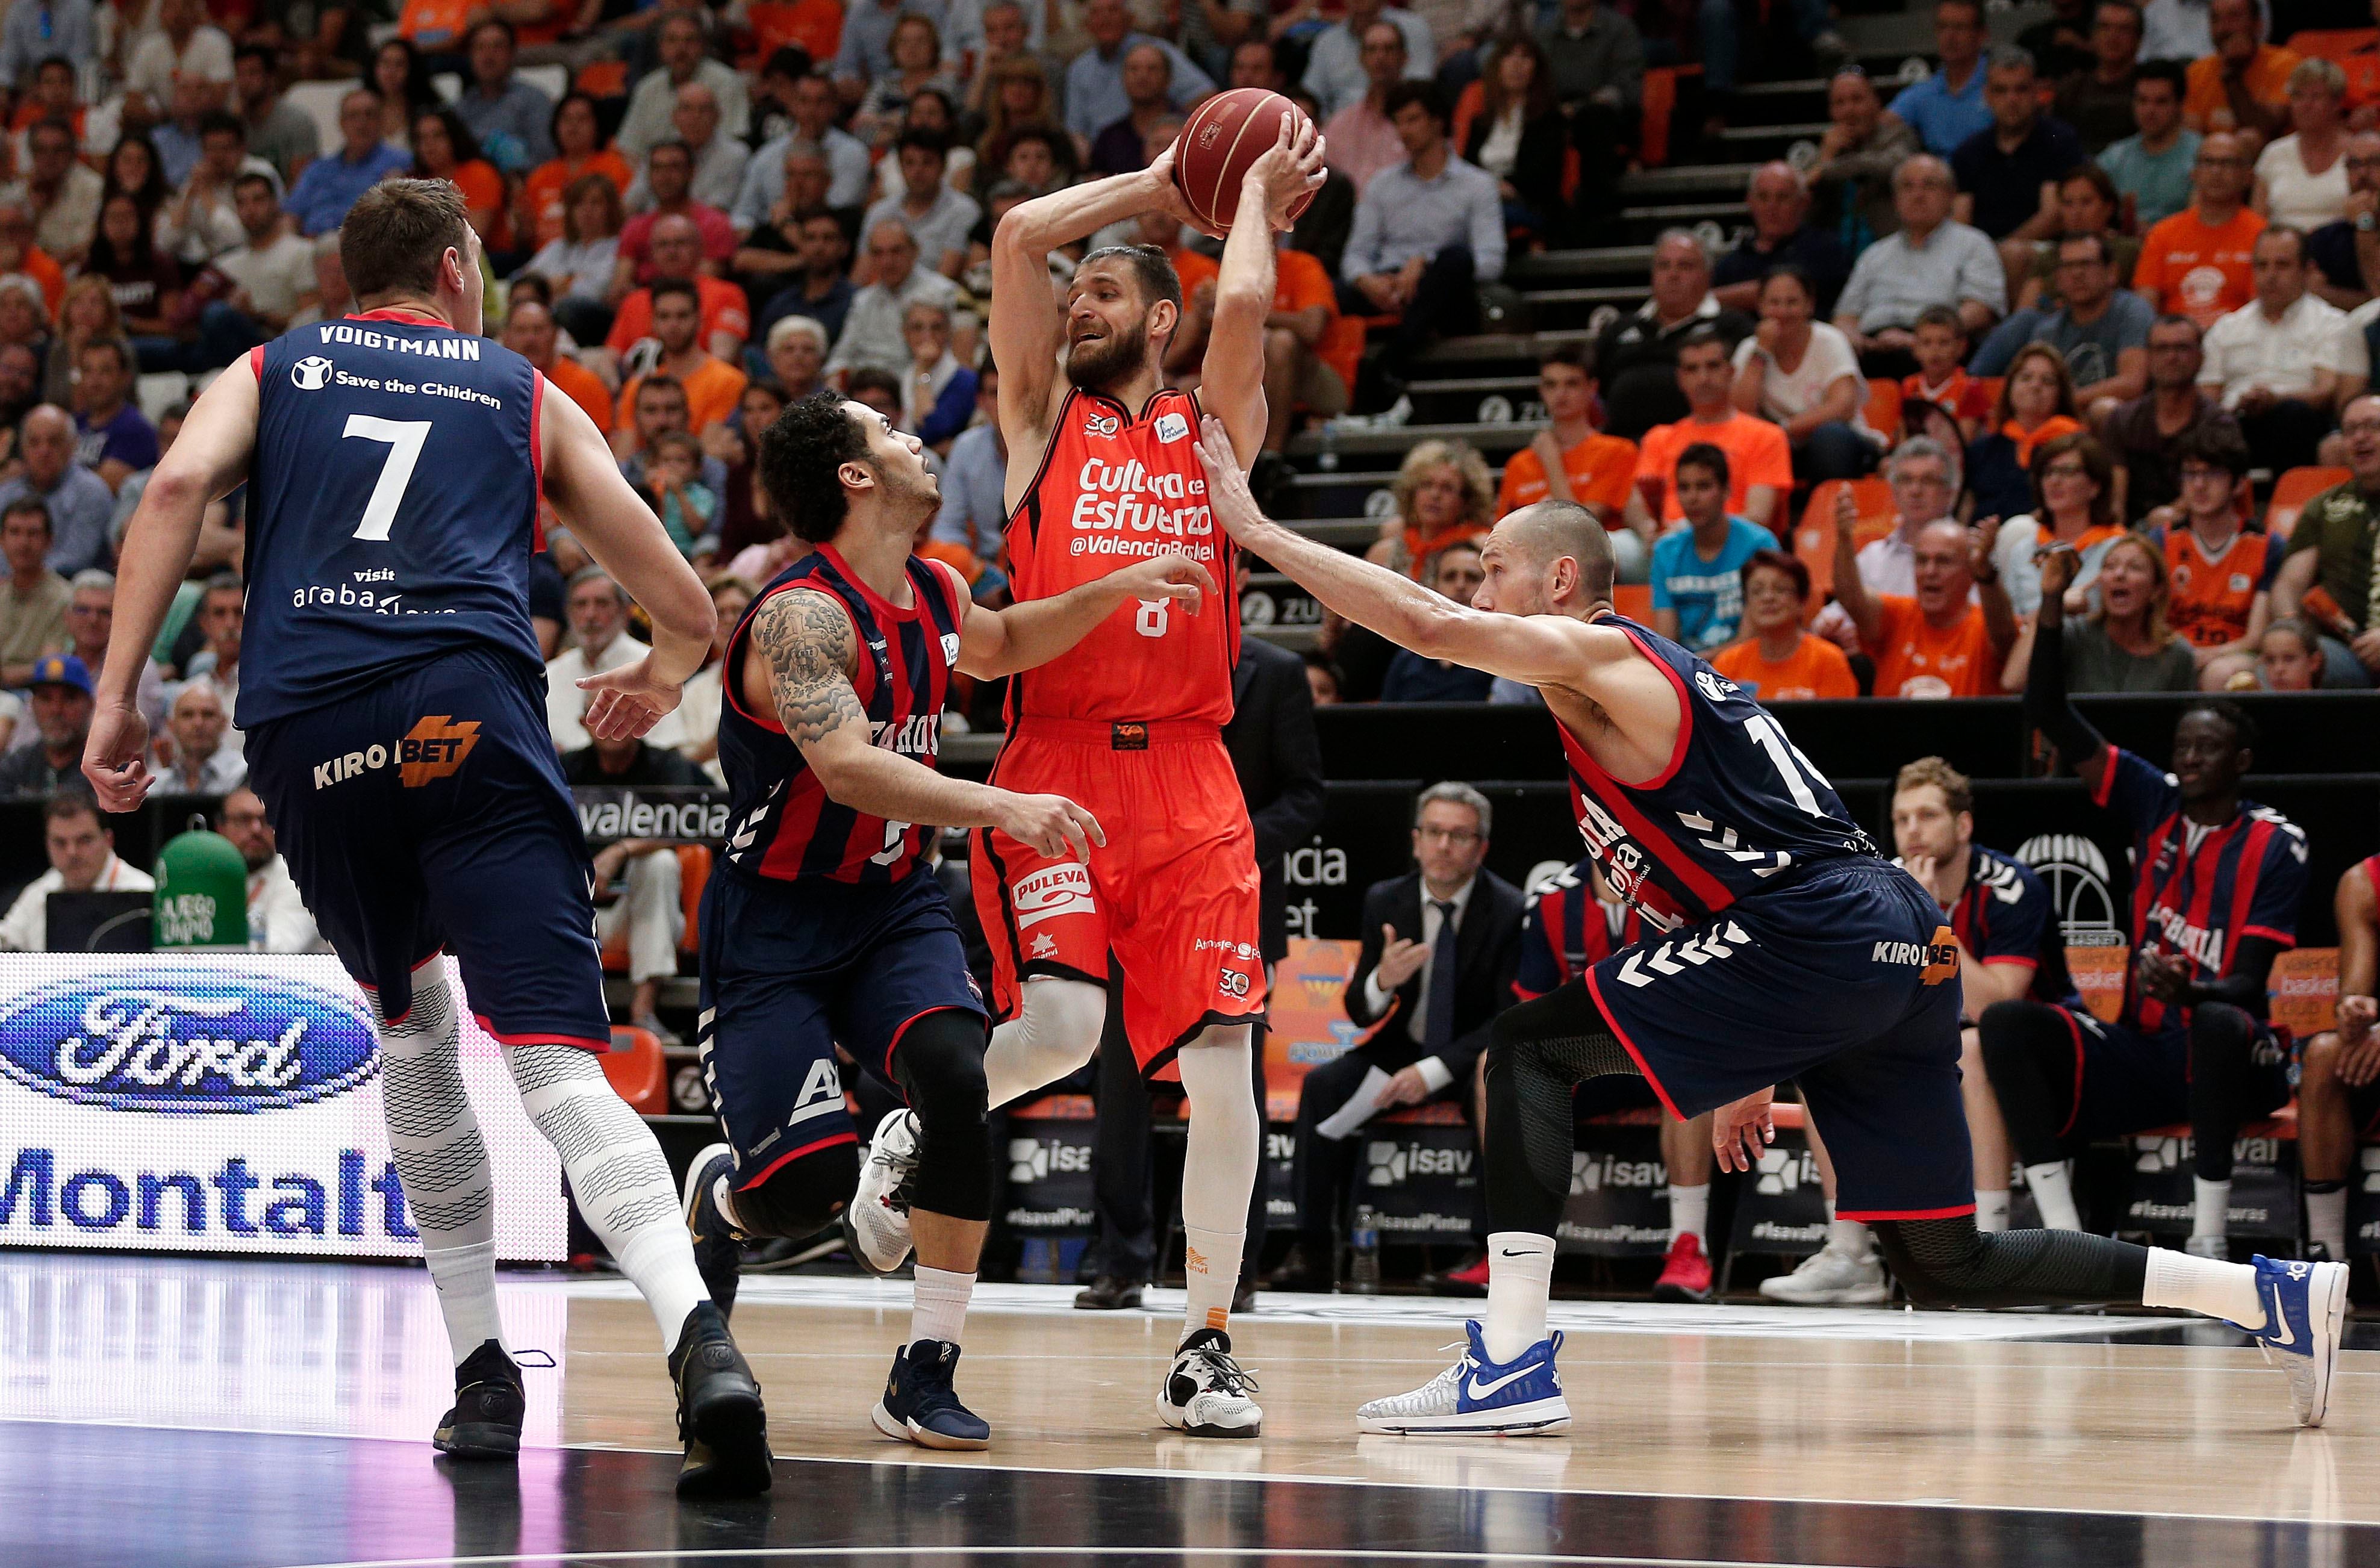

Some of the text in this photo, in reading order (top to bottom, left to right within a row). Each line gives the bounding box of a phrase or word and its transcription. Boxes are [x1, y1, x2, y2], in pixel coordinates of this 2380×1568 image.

[319, 325, 480, 361] VOIGTMANN
[335, 370, 501, 410] Save the Children
[342, 414, 434, 542] 7
[1071, 493, 1213, 537] Esfuerzo
[293, 583, 375, 608] araba
[354, 568, 396, 583] visit
[1136, 597, 1171, 638] 8
[578, 791, 731, 838] valencia
[1017, 870, 1087, 901] PULEVA
[2281, 974, 2340, 997] basket
[55, 988, 310, 1087] Ford
